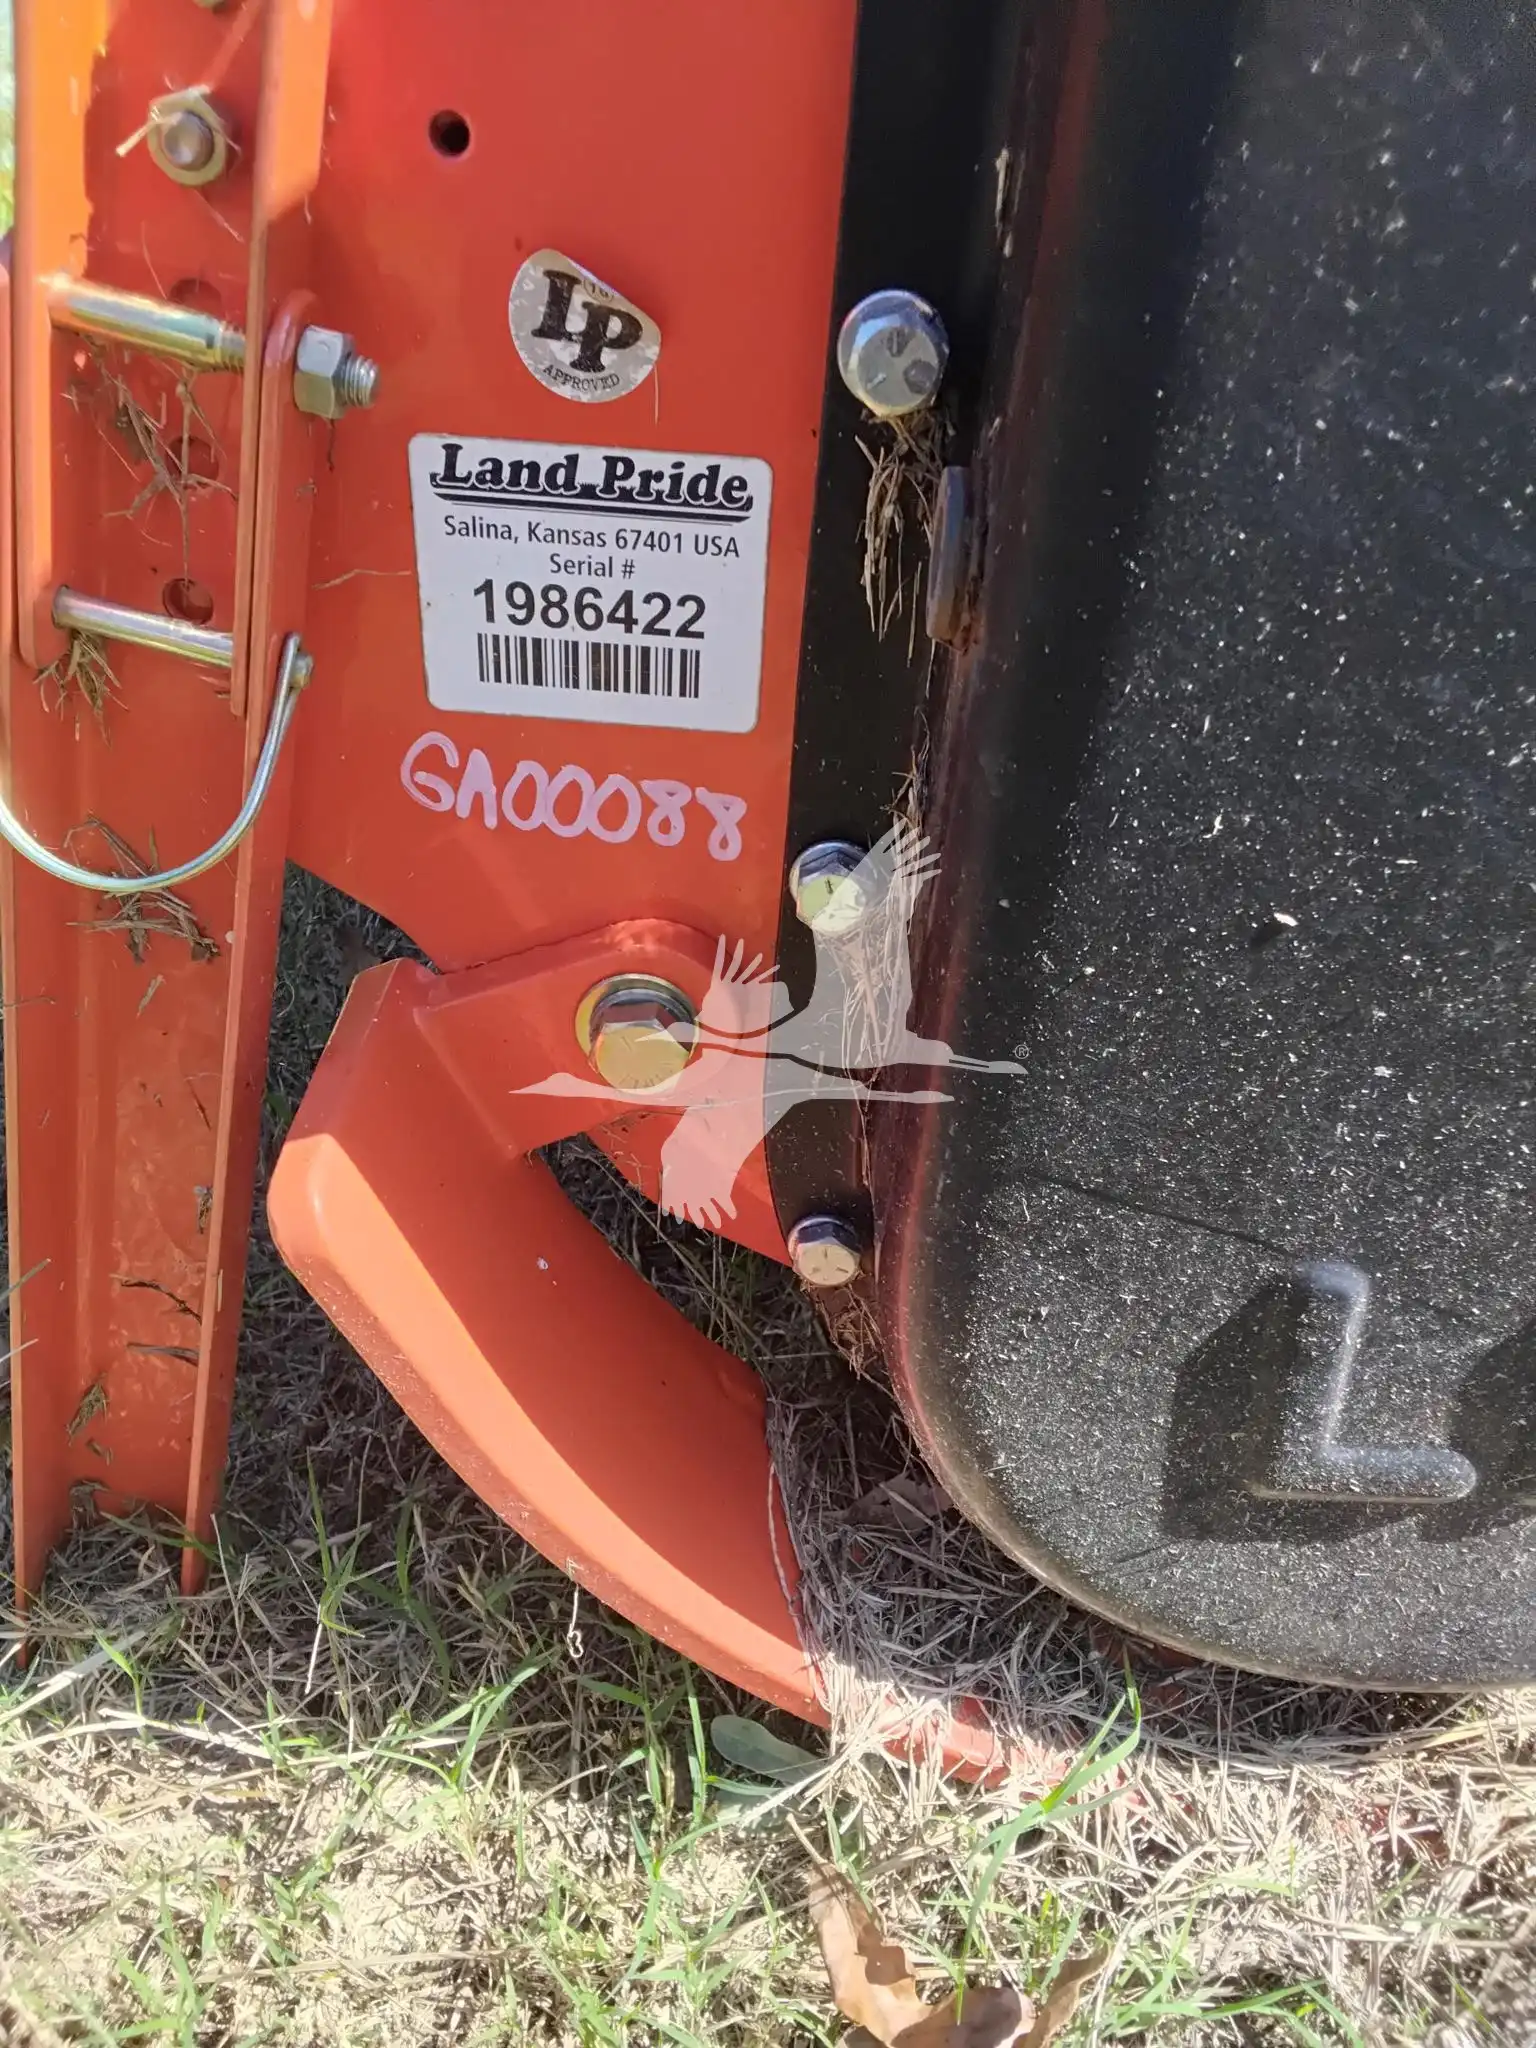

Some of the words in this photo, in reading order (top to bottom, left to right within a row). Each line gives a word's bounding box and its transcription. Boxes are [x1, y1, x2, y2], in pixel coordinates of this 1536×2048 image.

[530, 268, 644, 374] LP
[541, 363, 621, 392] APPROVED
[439, 443, 581, 496] Land
[598, 455, 752, 508] Pride
[443, 515, 519, 545] Salina,
[527, 521, 607, 549] Kansas
[615, 528, 683, 554] 67401
[694, 534, 741, 558] USA
[549, 552, 614, 578] Serial
[620, 558, 636, 579] #
[473, 577, 706, 640] 1986422
[400, 730, 748, 862] GA00088
